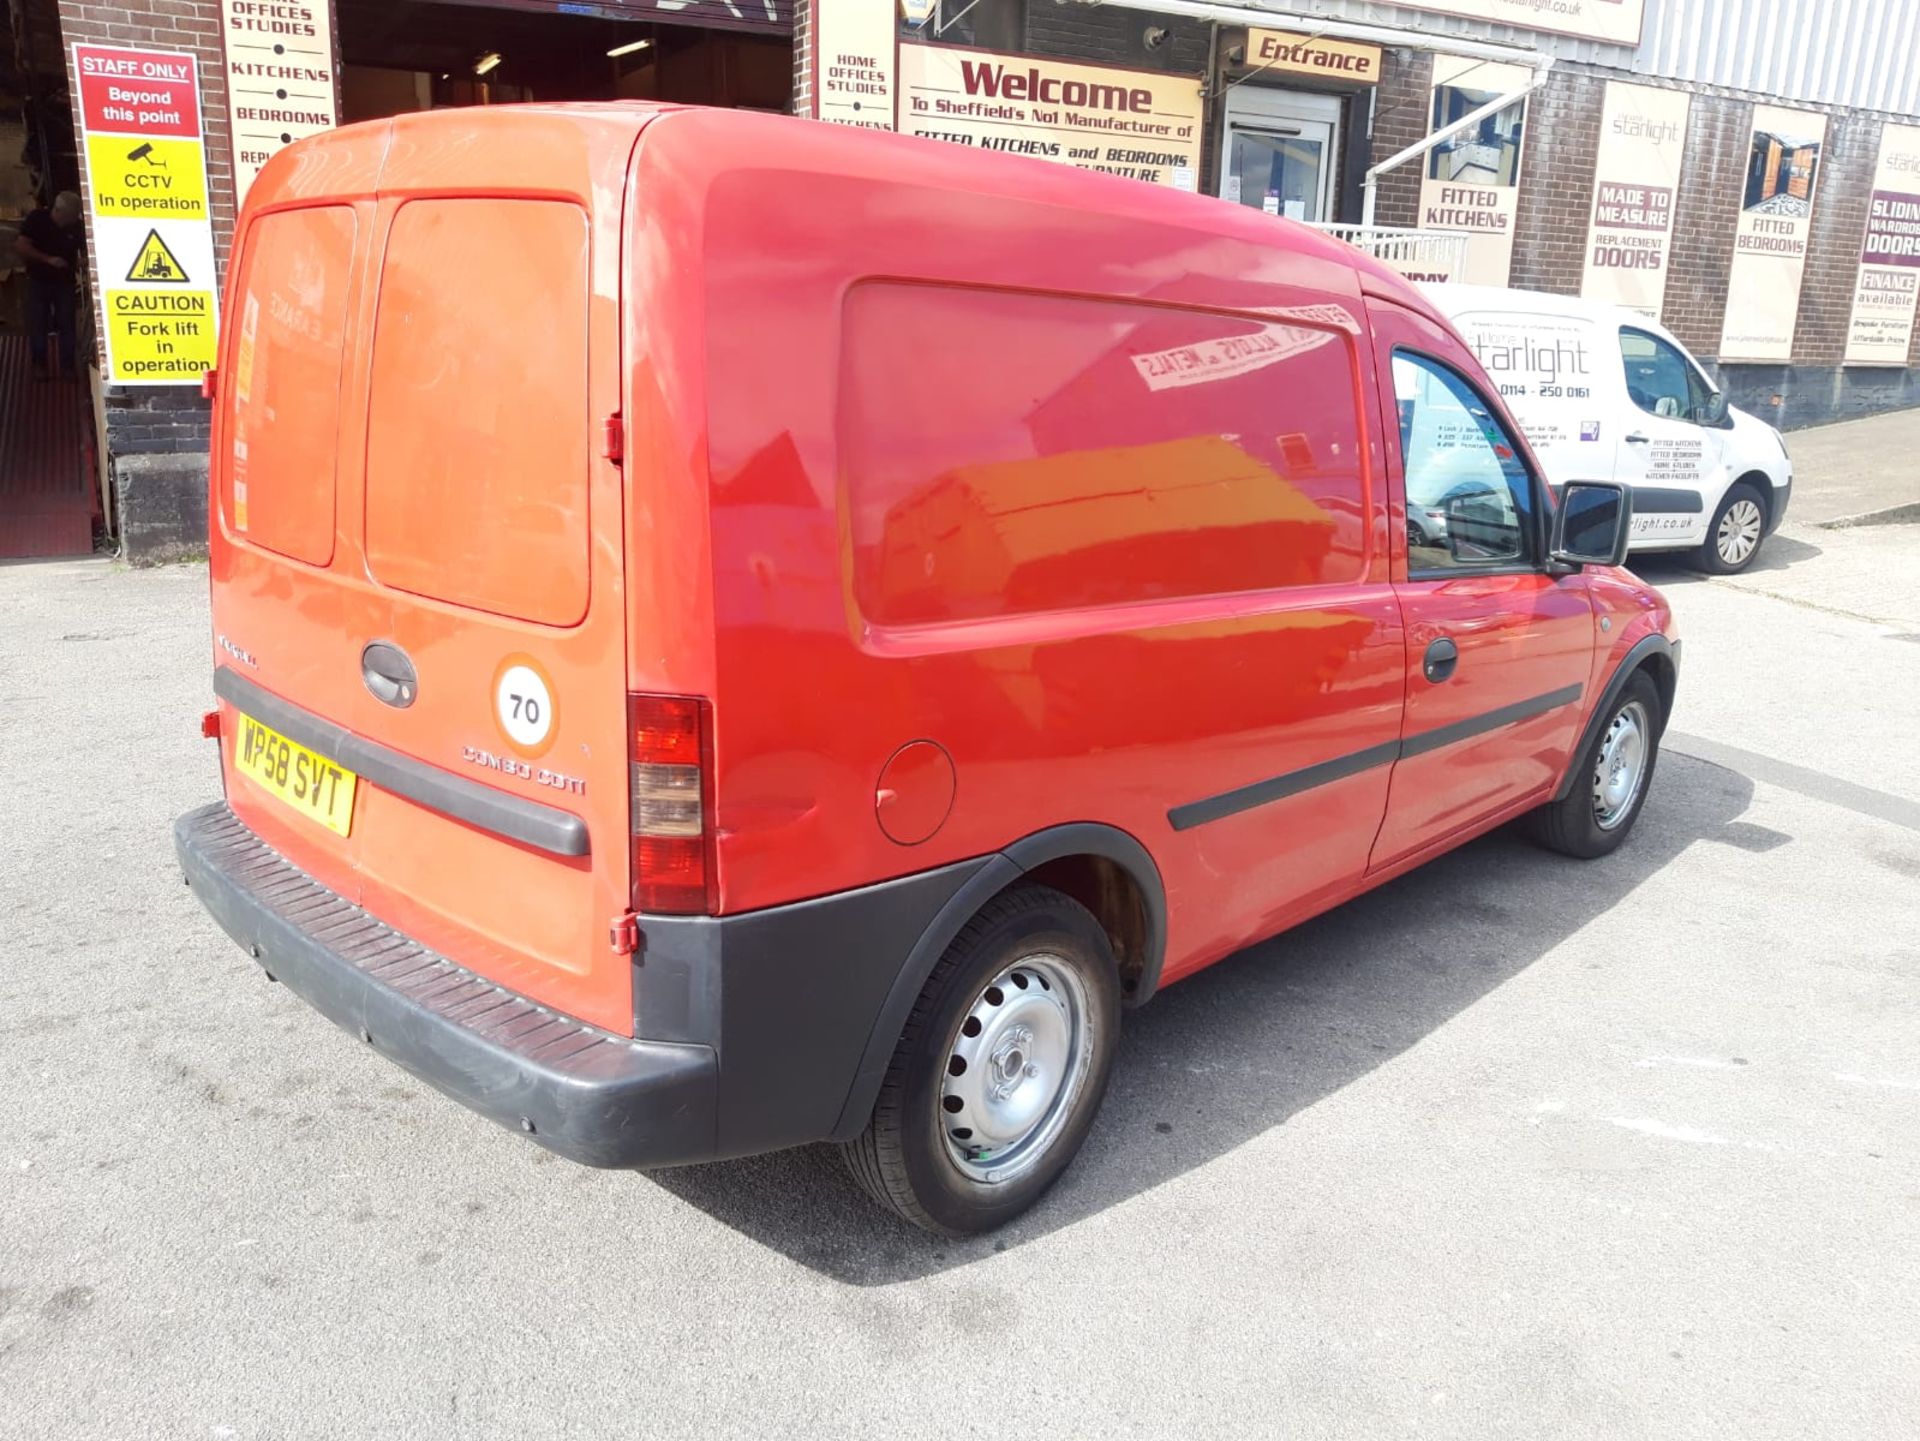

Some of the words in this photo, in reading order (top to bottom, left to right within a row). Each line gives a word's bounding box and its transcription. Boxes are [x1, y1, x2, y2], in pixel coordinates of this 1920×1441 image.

[232, 1, 312, 20] OFFICES
[230, 17, 316, 36] STUDIES
[837, 54, 877, 68] HOME
[1258, 36, 1370, 73] Entrance
[82, 56, 138, 74] STAFF
[142, 62, 188, 79] ONLY
[231, 61, 329, 82] KITCHENS
[829, 67, 885, 82] OFFICES
[108, 87, 172, 106] Beyond
[827, 80, 887, 95] STUDIES
[960, 60, 1152, 114] Welcome
[103, 106, 135, 121] this
[139, 110, 181, 125] point
[236, 107, 330, 126] BEDROOMS
[910, 96, 929, 111] To
[935, 99, 1026, 120] Sheffield's
[1032, 109, 1059, 124] No1
[1064, 112, 1172, 135] Manufacturer
[1177, 125, 1194, 137] of
[1613, 117, 1679, 145] starlight
[981, 136, 1061, 156] KITCHENS
[1068, 146, 1099, 160] and
[1105, 148, 1189, 168] BEDROOMS
[124, 173, 172, 189] CCTV
[99, 193, 115, 207] In
[120, 196, 201, 211] operation
[1441, 187, 1498, 207] FITTED
[1601, 186, 1645, 206] MADE
[1650, 190, 1669, 208] TO
[1425, 207, 1508, 228] KITCHENS
[1597, 206, 1668, 228] MEASURE
[1752, 218, 1795, 235] FITTED
[1595, 234, 1663, 249] REPLACEMENT
[1738, 234, 1805, 253] BEDROOMS
[1592, 247, 1662, 270] DOORS
[1863, 272, 1915, 290] FINANCE
[116, 295, 205, 310] CAUTION
[1858, 292, 1913, 306] available
[128, 321, 170, 336] Fork
[175, 322, 200, 336] lift
[156, 339, 174, 354] in
[122, 358, 211, 375] operation
[1470, 333, 1590, 384] tarlight
[1500, 384, 1526, 396] 0114
[1540, 385, 1563, 397] 250
[1567, 387, 1590, 398] 0161
[510, 693, 540, 724] 70
[244, 718, 290, 788] WP58
[293, 751, 343, 816] SVT
[463, 746, 532, 781] COMBO
